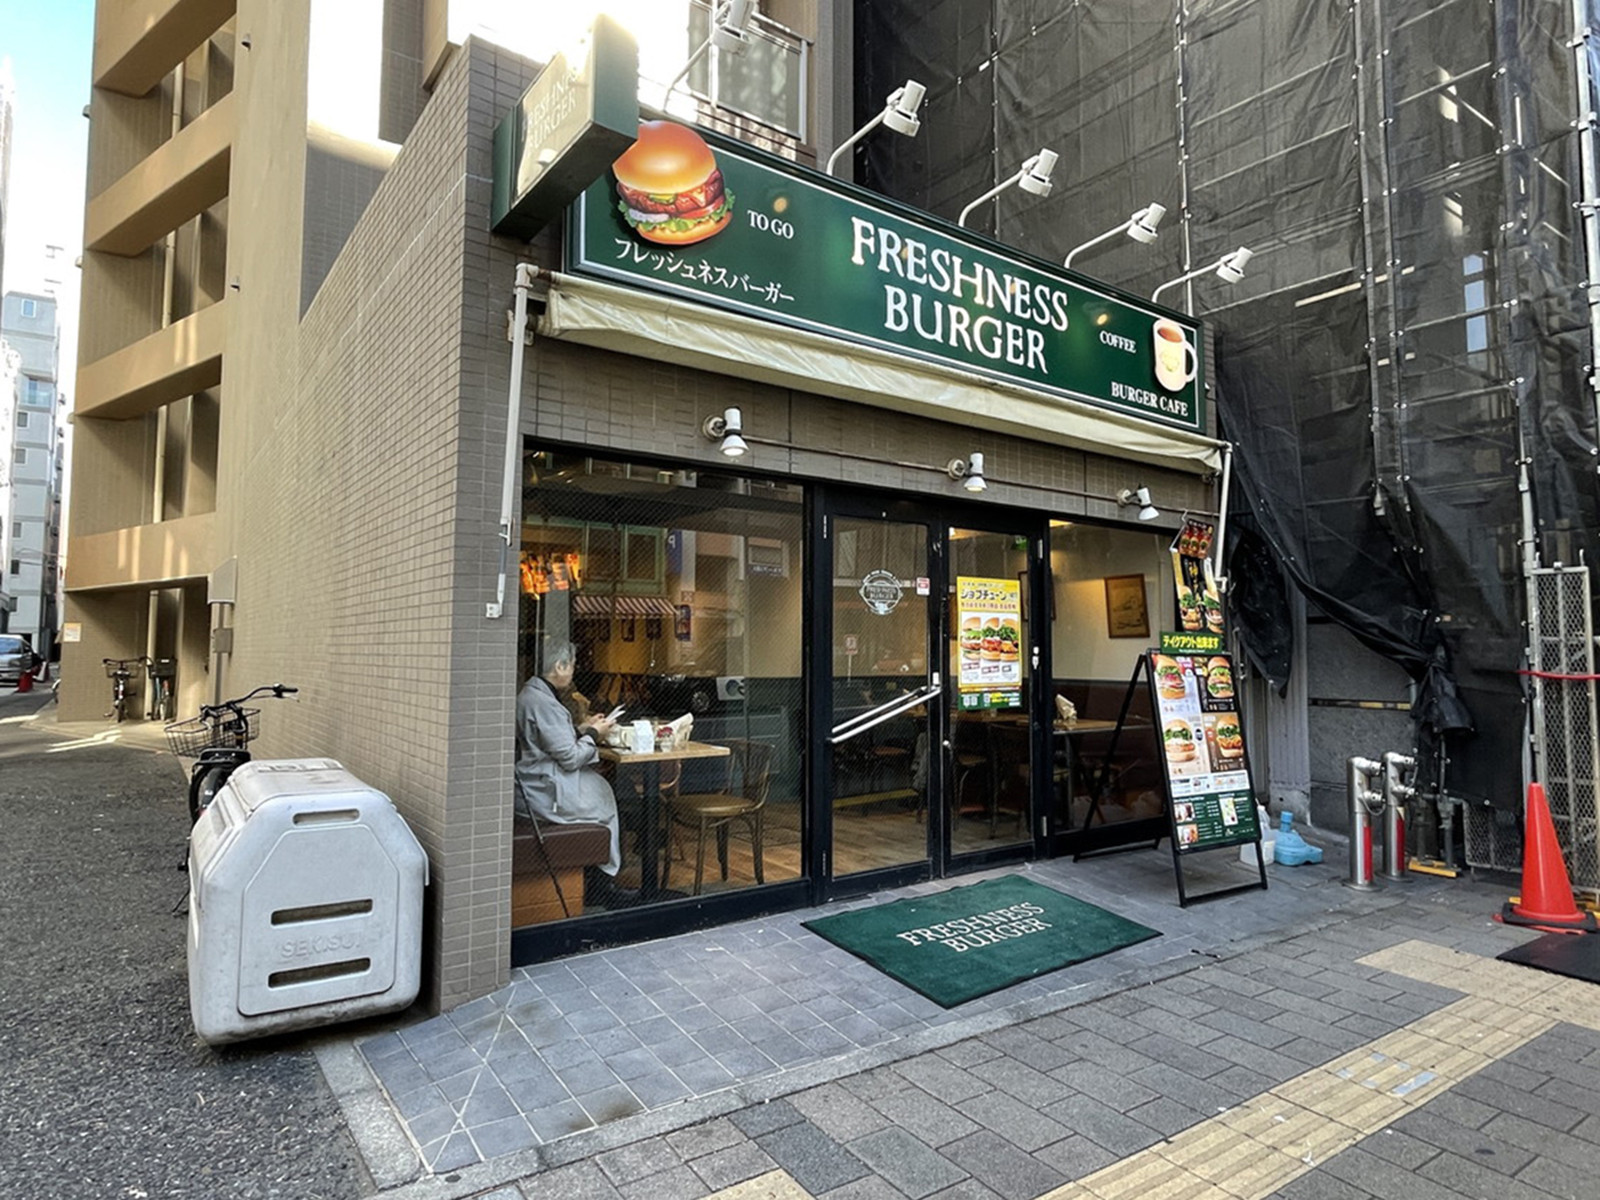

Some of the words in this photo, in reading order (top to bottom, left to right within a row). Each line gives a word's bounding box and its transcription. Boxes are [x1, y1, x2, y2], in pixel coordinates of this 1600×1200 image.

[747, 210, 770, 230] TO
[771, 218, 794, 240] GO
[614, 238, 795, 304] フレッシュネスバーガー
[850, 216, 1069, 332] FRESHNESS
[884, 284, 1049, 374] BURGER
[1099, 329, 1137, 354] COFFEE
[1110, 381, 1158, 409] BURGER
[1159, 396, 1189, 417] CAFE
[896, 901, 1046, 946] FRESHNESS
[939, 916, 1053, 953] BURGER
